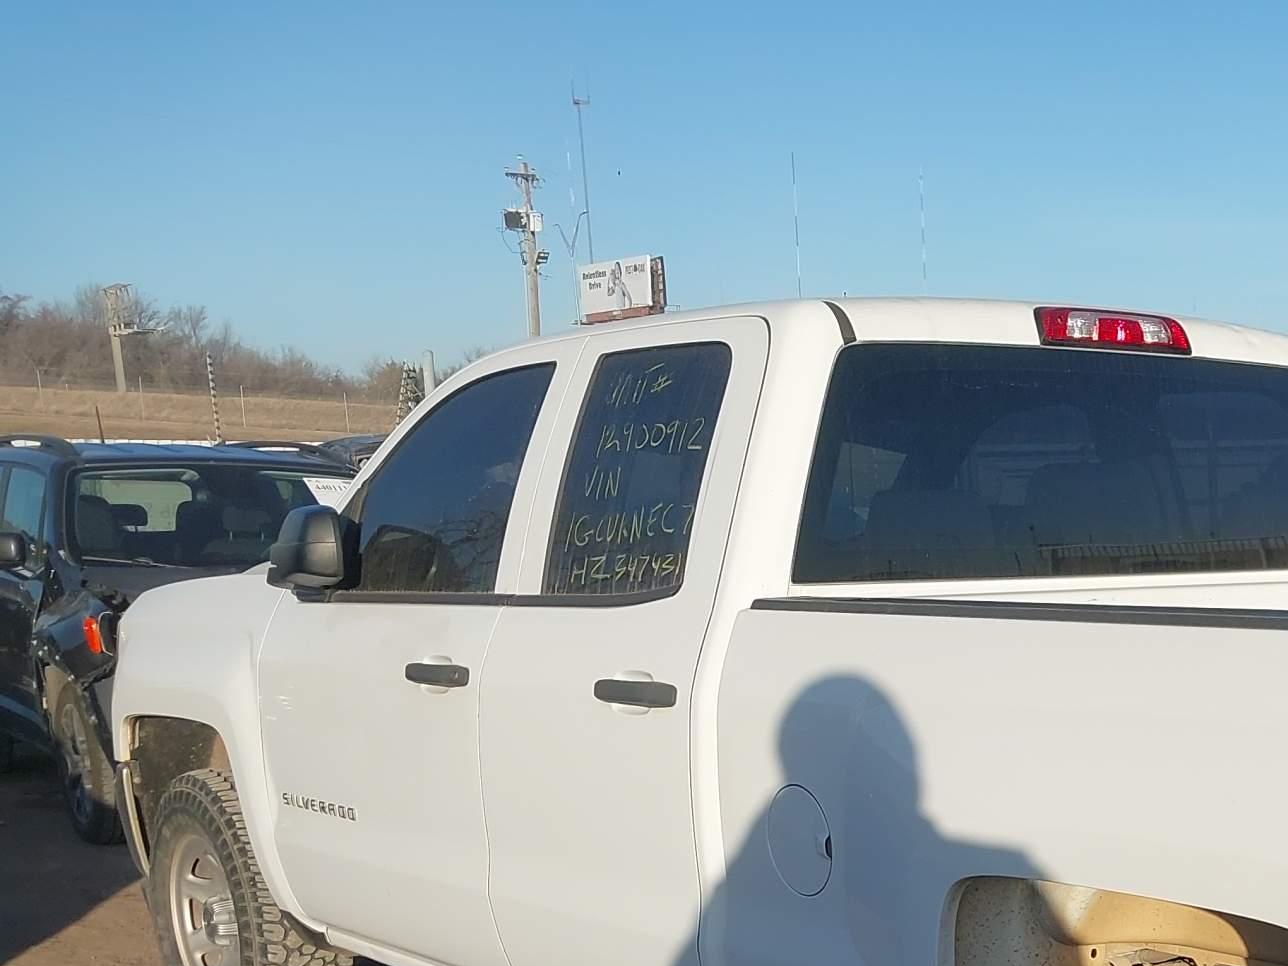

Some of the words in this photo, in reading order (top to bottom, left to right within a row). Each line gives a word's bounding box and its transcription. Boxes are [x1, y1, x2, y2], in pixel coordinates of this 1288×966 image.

[588, 281, 602, 291] Drive
[585, 466, 622, 501] VIN
[282, 792, 357, 821] SILVERADO
